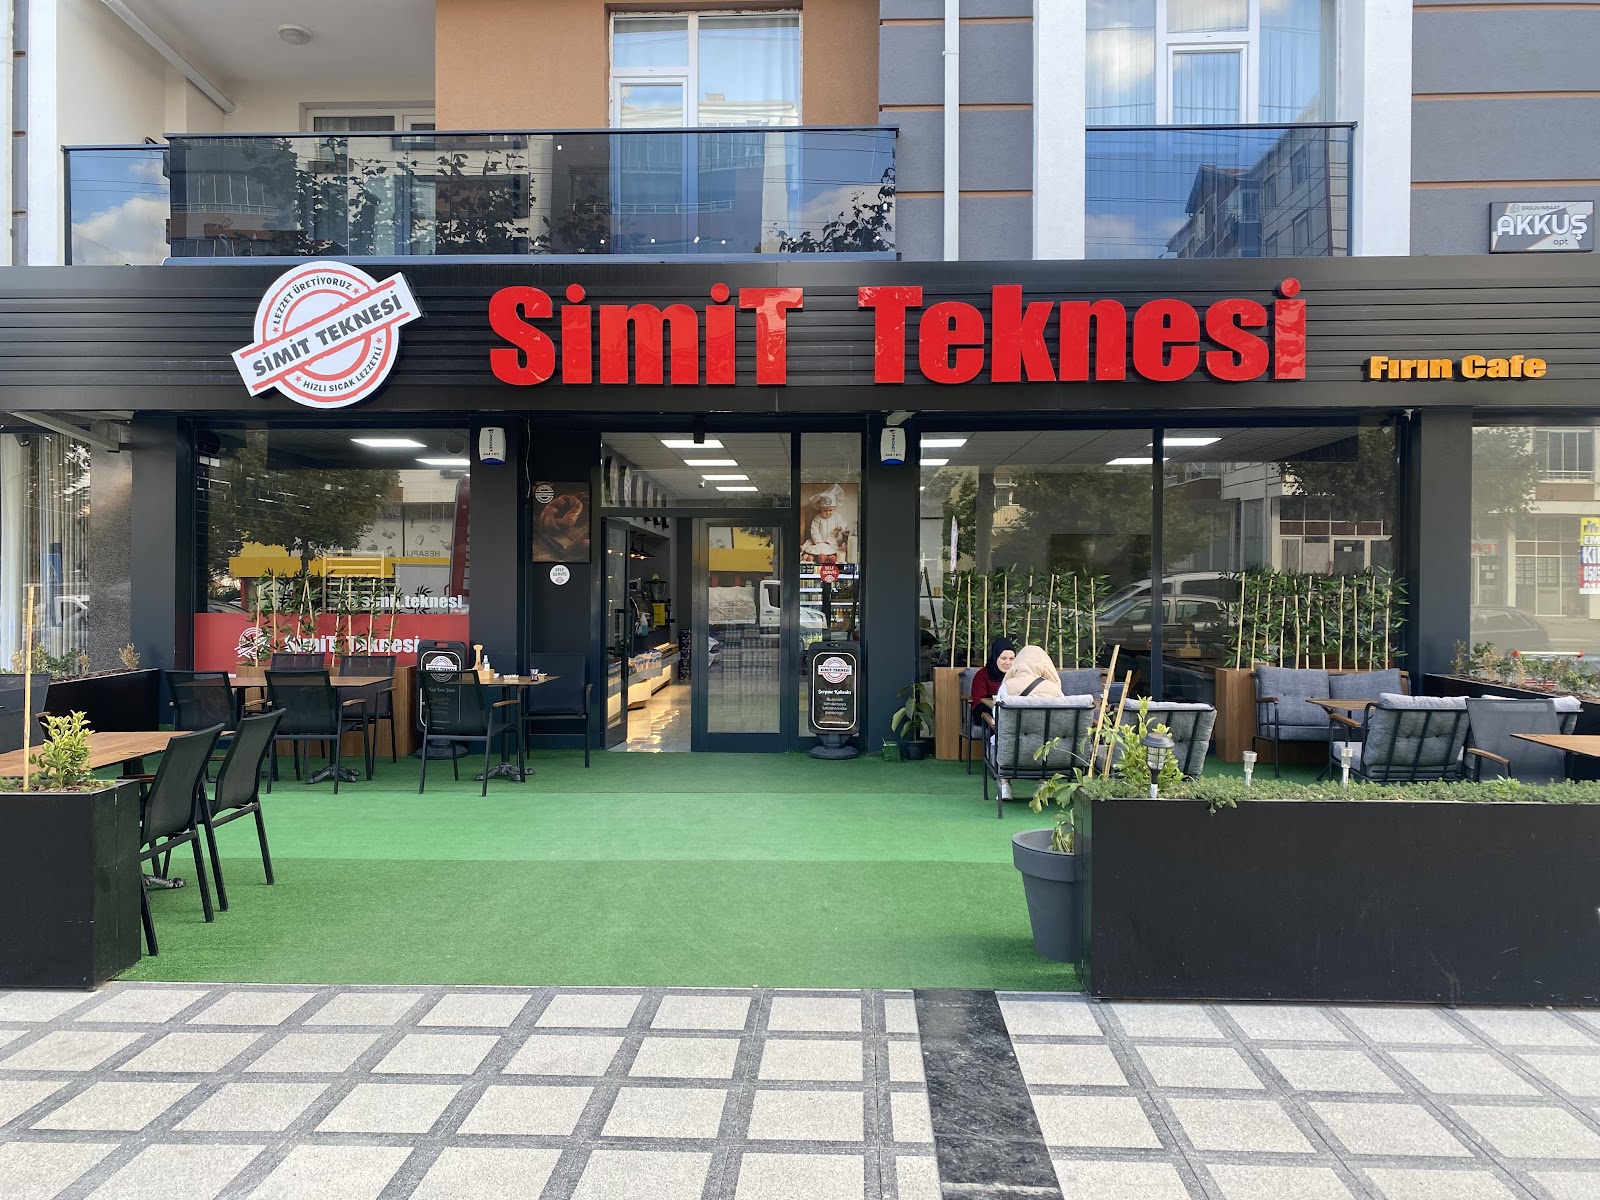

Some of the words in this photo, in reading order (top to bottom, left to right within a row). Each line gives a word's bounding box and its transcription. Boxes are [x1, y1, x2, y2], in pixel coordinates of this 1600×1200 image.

[1497, 214, 1588, 240] AKKUŞ
[1553, 238, 1569, 247] apt
[273, 292, 294, 324] LEZZET
[293, 275, 353, 293] ÜRETİYORUZ
[252, 338, 311, 377] SİMİT
[315, 290, 403, 346] TEKNESİ
[488, 283, 804, 386] SimiT
[857, 277, 1306, 384] Teknesi
[303, 380, 327, 392] HIZLI
[329, 378, 356, 392] SICAK
[355, 346, 383, 383] LEZZETLİ
[1370, 355, 1453, 379] Fırın
[1461, 354, 1547, 379] Cafe
